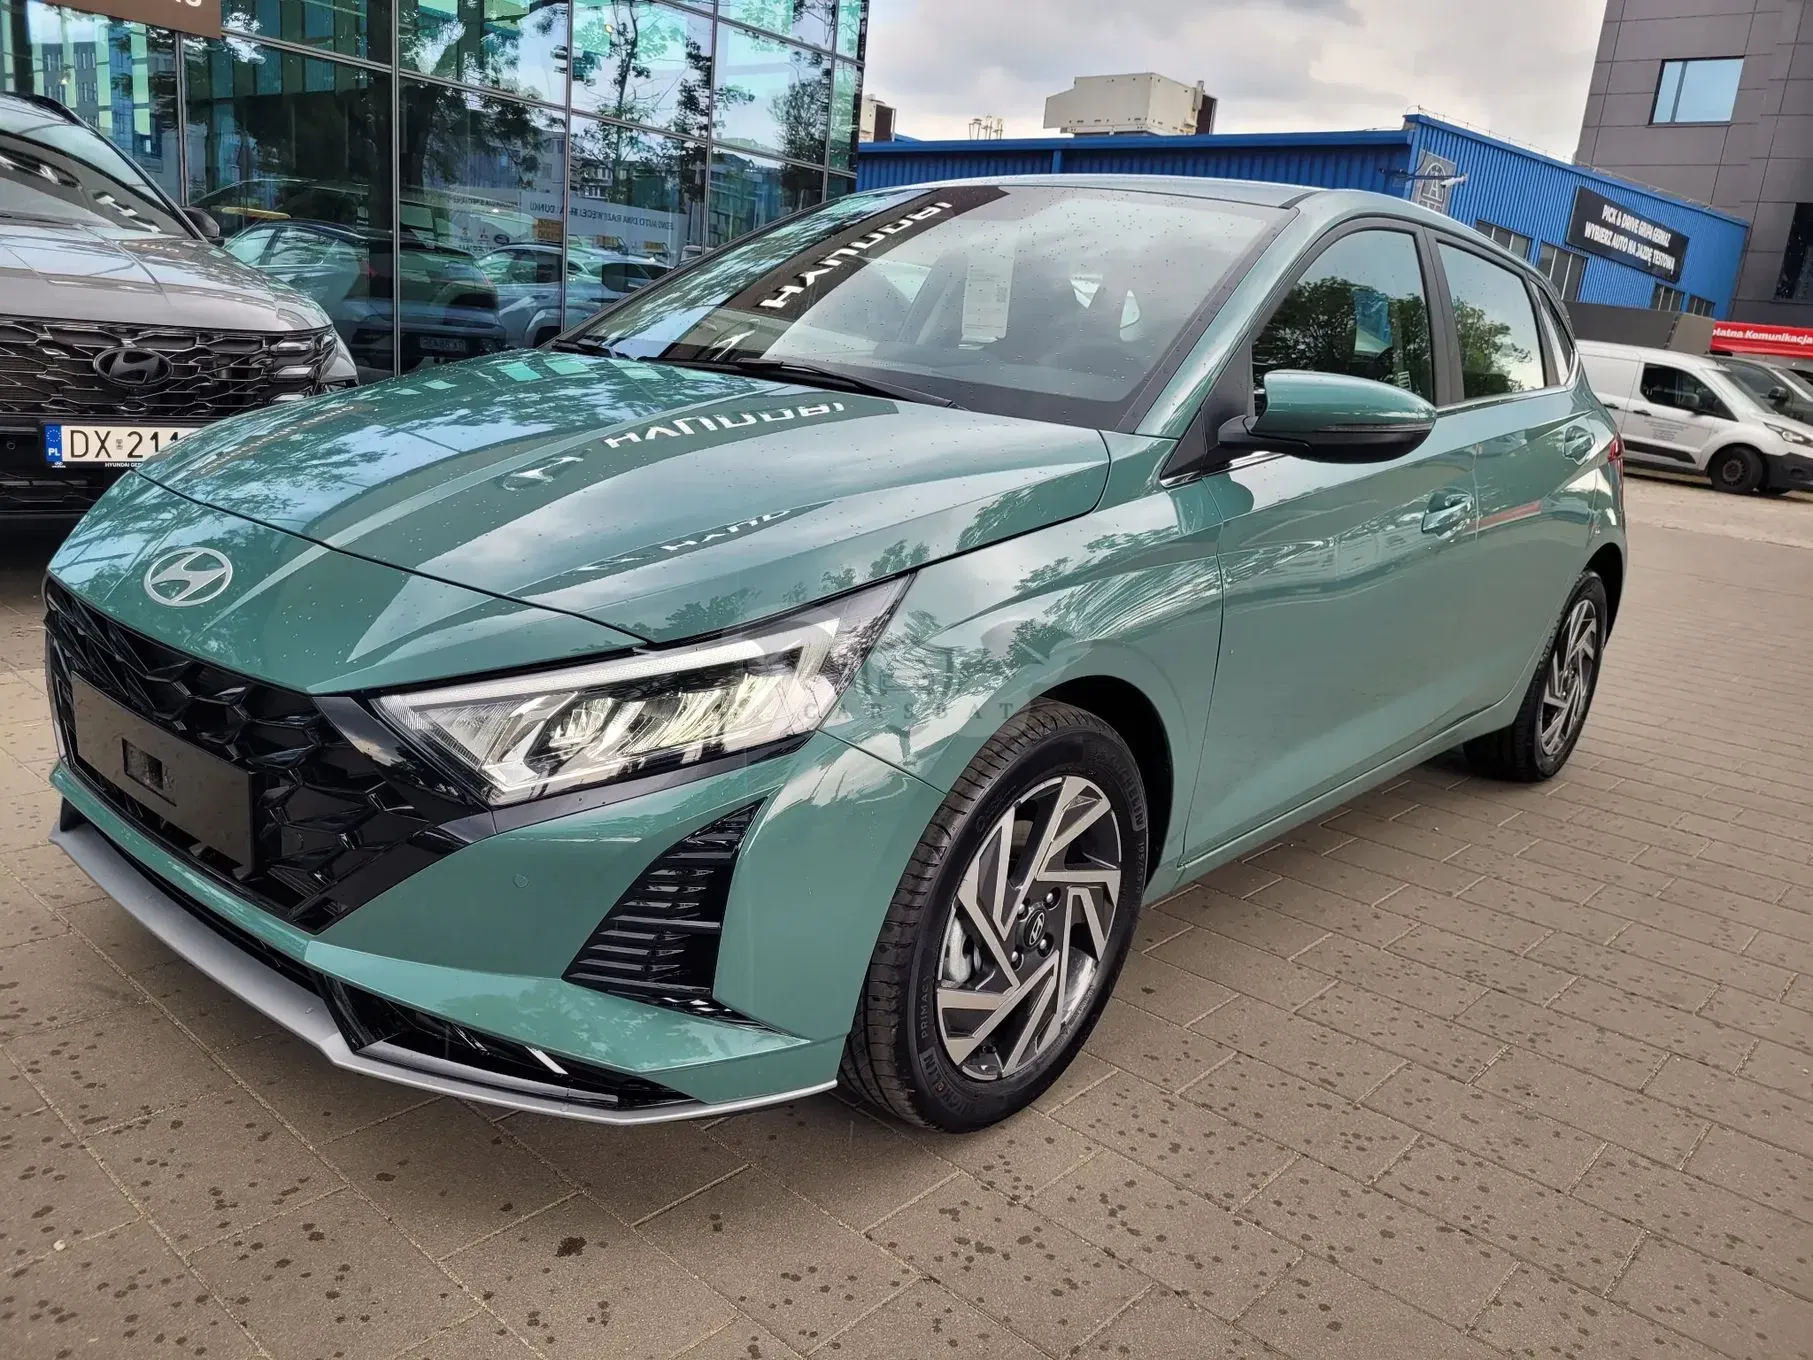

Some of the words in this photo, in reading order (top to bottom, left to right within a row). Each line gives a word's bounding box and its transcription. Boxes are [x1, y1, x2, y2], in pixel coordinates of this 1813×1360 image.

[1601, 204, 1618, 225] PICK
[1621, 213, 1640, 234] DRIVE
[1584, 221, 1613, 247] WYBIERZ
[1611, 233, 1628, 252] AUTO
[1626, 240, 1637, 256] NA
[1635, 243, 1653, 267] JAZDĘ
[1744, 330, 1813, 345] Komunikacja
[47, 447, 62, 457] PL
[70, 429, 112, 459] DX
